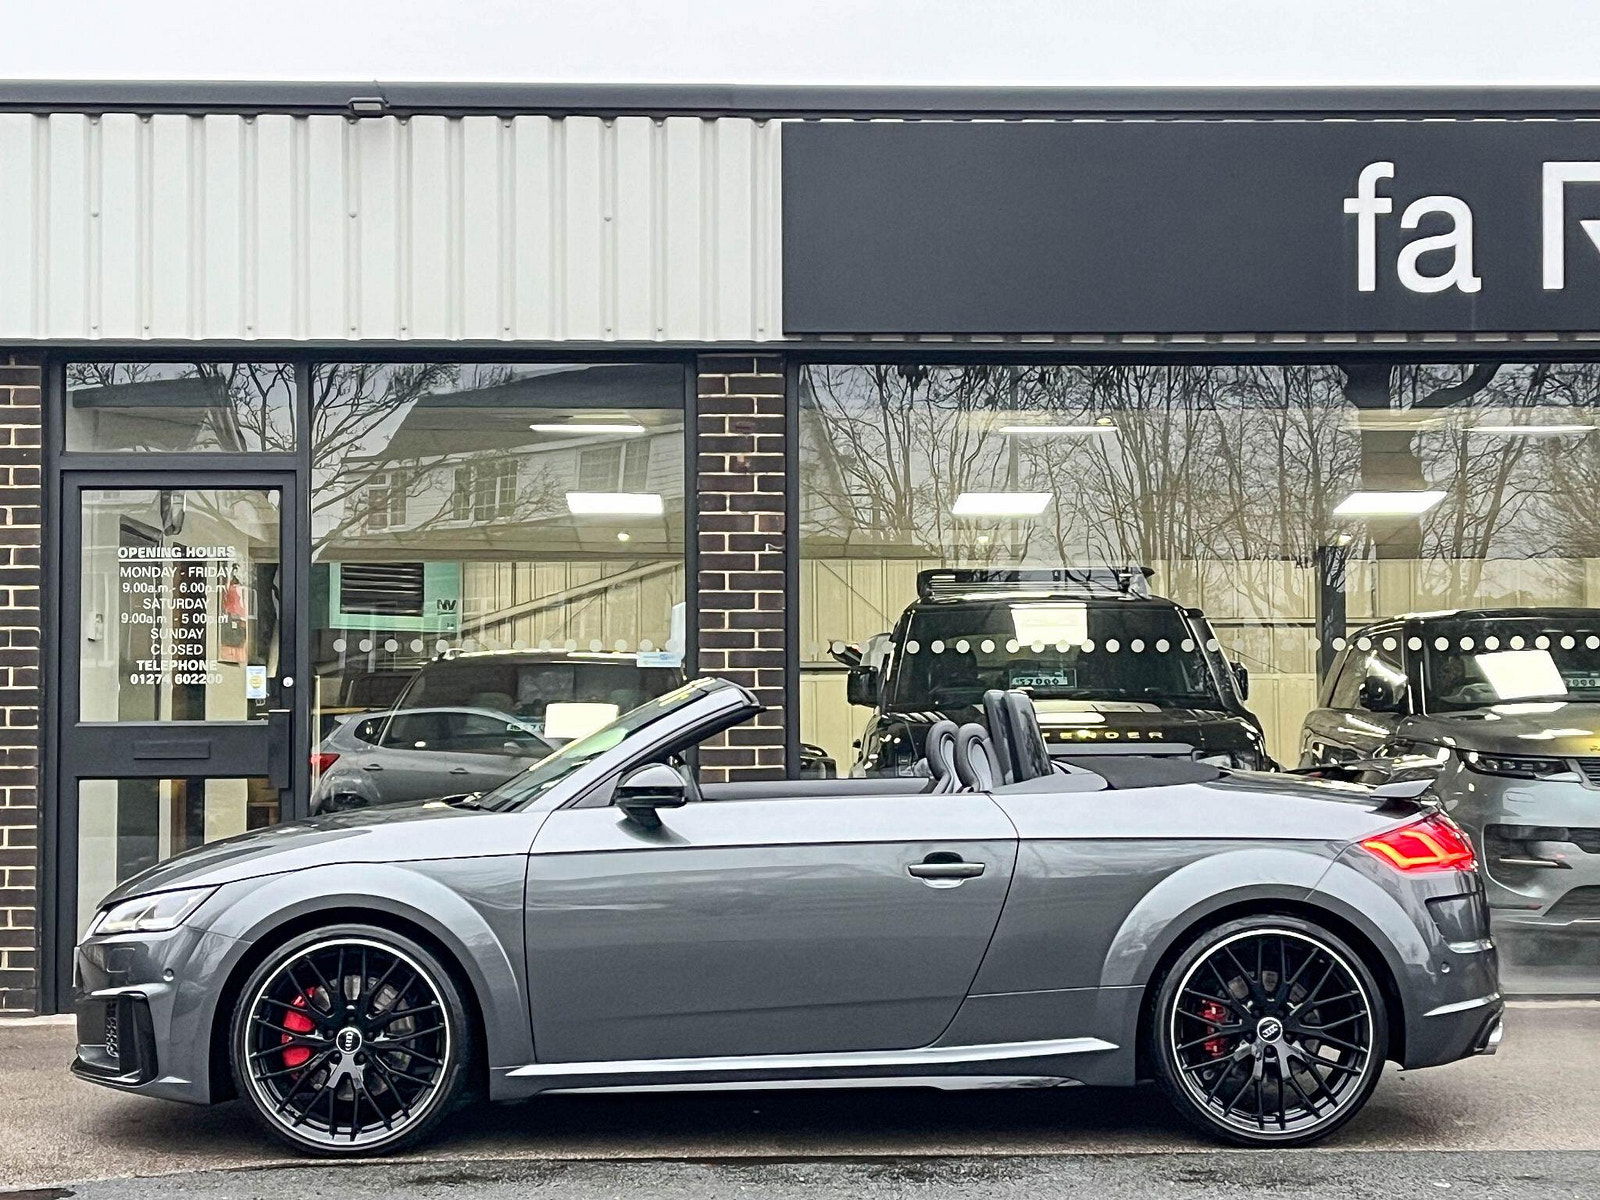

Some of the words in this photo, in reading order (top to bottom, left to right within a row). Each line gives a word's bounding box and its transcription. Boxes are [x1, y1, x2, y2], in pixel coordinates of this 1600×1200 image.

[1343, 161, 1482, 293] fa
[118, 547, 182, 559] OPENING
[185, 546, 236, 558] HOURS
[120, 566, 177, 578] MONDAY
[188, 566, 233, 578] FRIDAY
[143, 598, 209, 610] SATURDAY
[150, 628, 204, 640] SUNDAY
[150, 643, 204, 655] CLOSED
[136, 660, 218, 671] TELEPHONE
[175, 673, 223, 685] 602200
